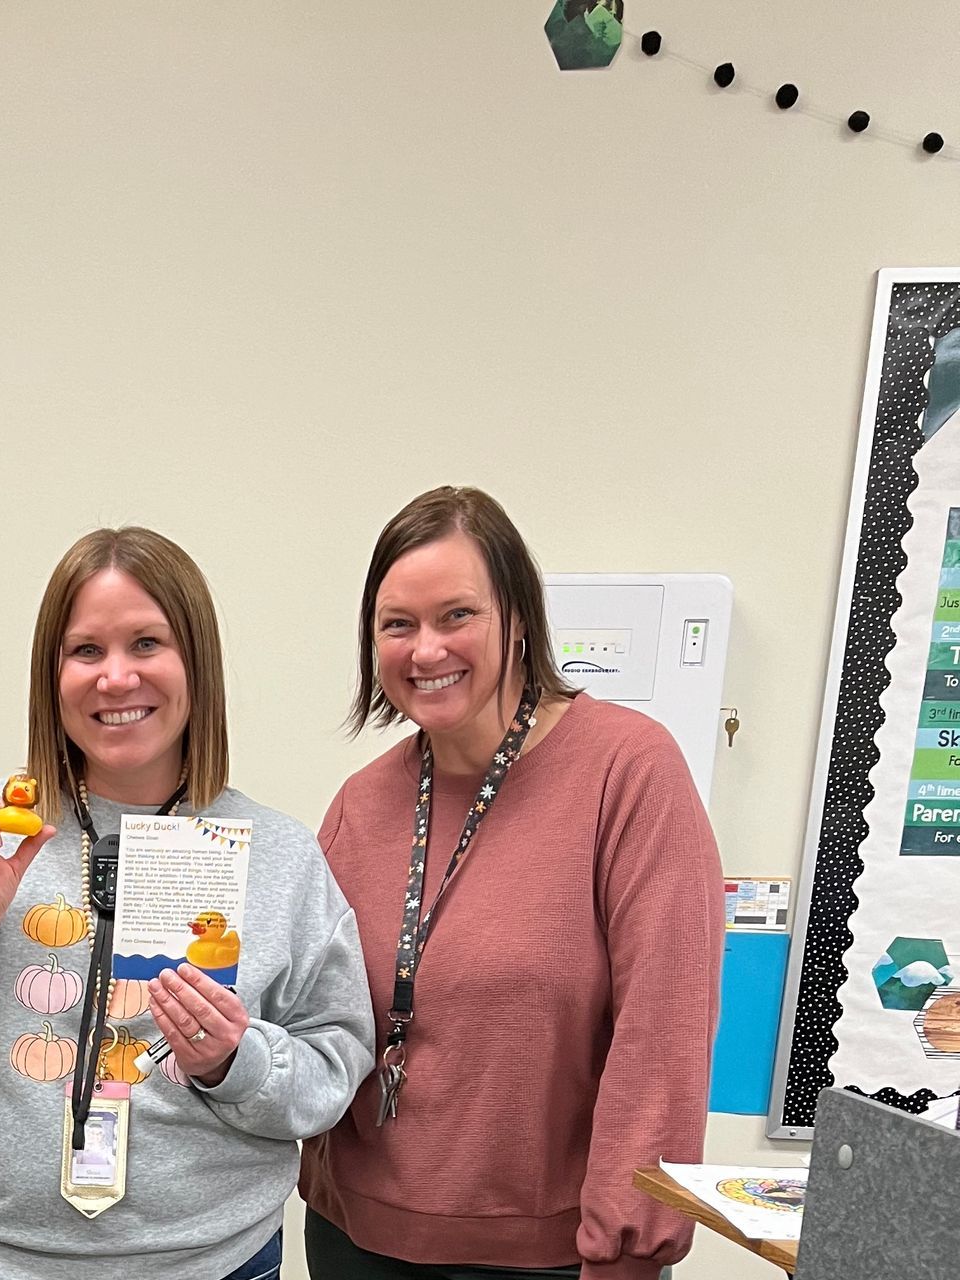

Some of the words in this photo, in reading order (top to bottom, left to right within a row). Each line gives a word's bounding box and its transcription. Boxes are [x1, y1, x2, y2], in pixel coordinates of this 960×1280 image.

[928, 706, 947, 720] 3rd
[918, 784, 935, 796] 4th
[125, 820, 151, 832] Lucky
[153, 822, 180, 832] Duck!
[934, 831, 955, 843] For
